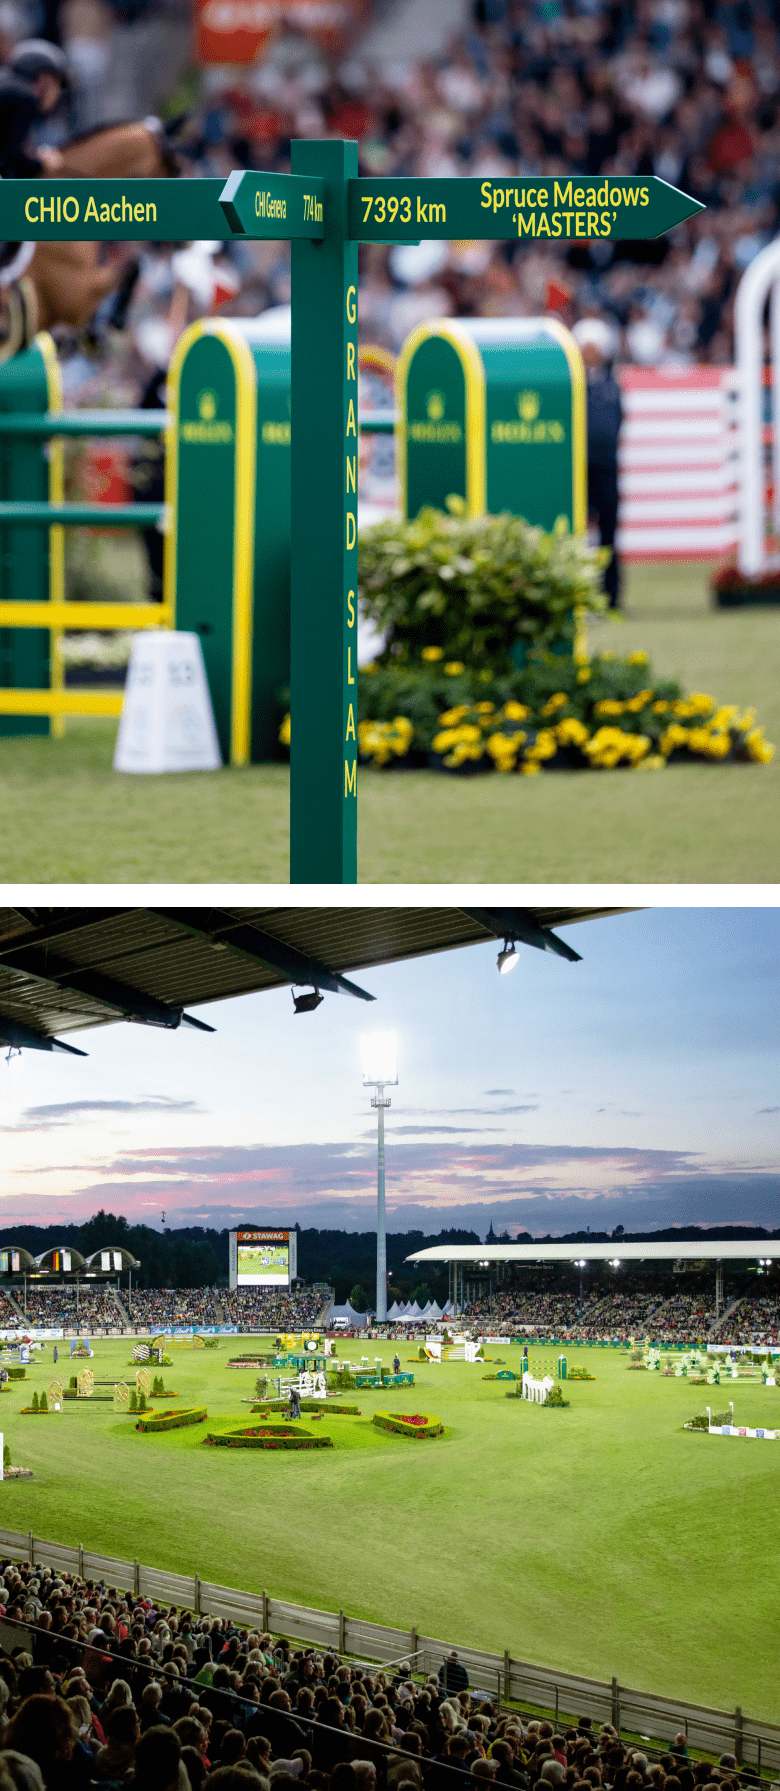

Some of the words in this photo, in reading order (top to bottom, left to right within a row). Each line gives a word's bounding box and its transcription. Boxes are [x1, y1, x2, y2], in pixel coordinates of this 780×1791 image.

[25, 196, 79, 222] CHIO
[84, 195, 157, 222] Aachen
[255, 191, 265, 217] CHI
[266, 191, 287, 218] Geneva
[303, 195, 313, 221] 774
[314, 195, 323, 222] km
[361, 196, 412, 222] 7393
[416, 196, 446, 222] km
[480, 181, 548, 213] Spruce
[553, 180, 649, 207] Meadows
[346, 285, 356, 550] GRAND
[344, 590, 357, 798] SLAM
